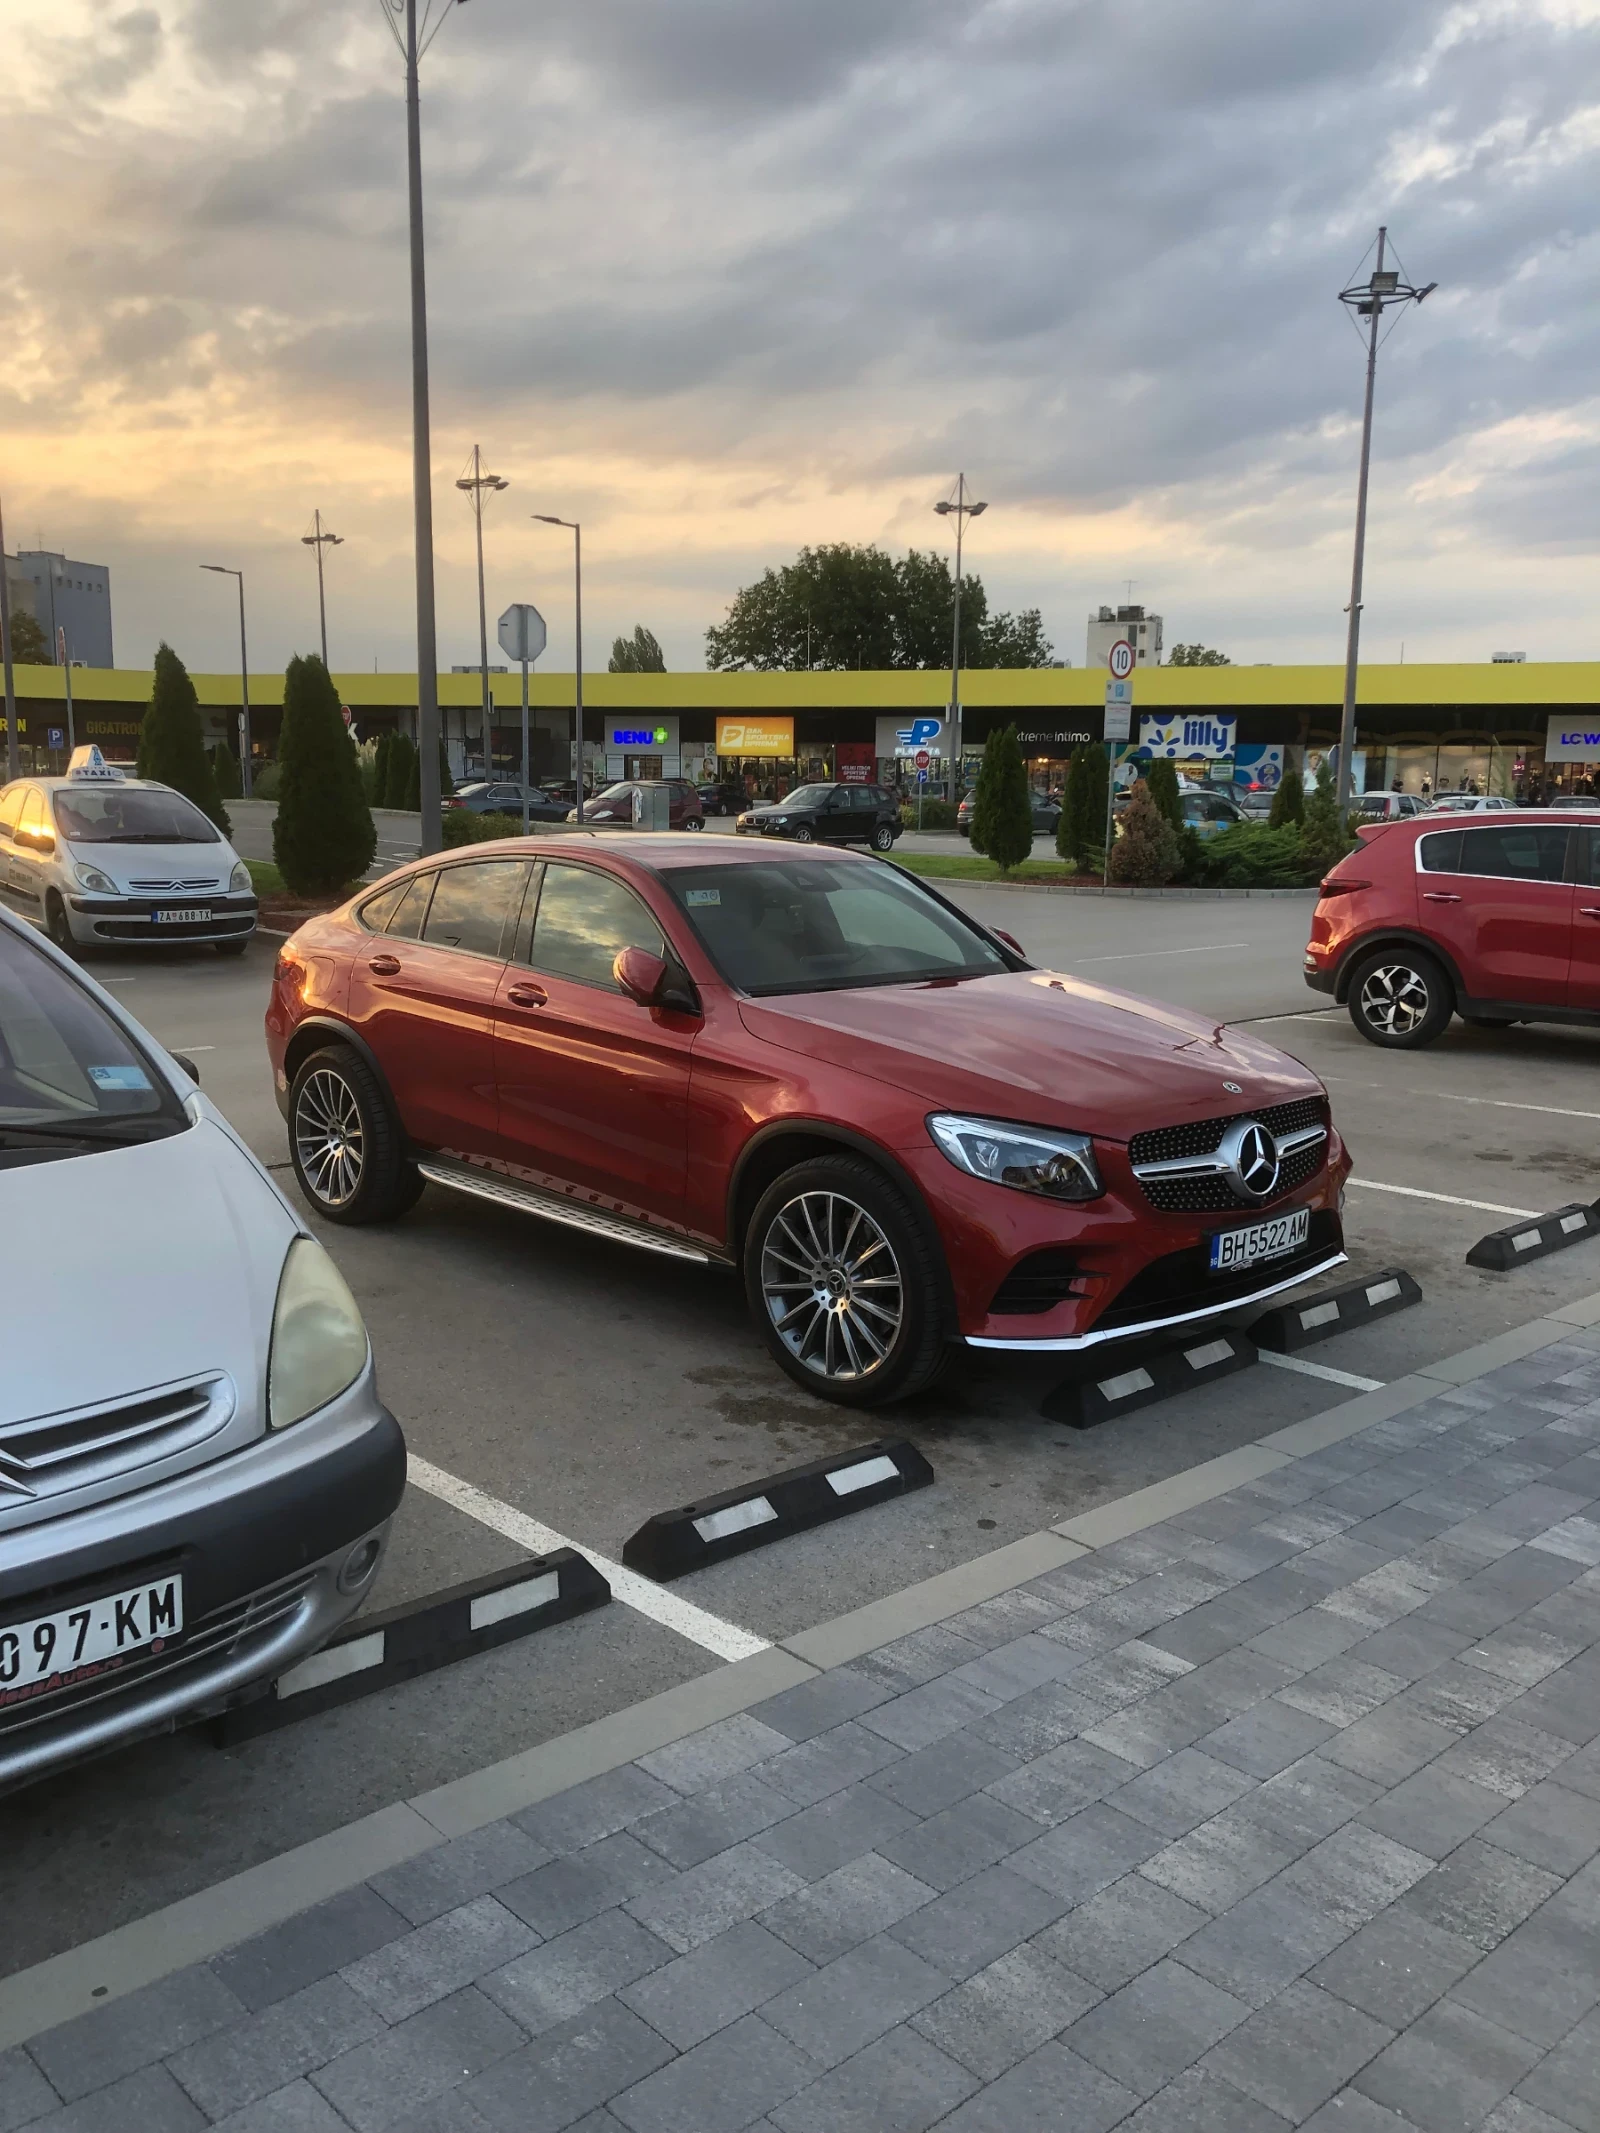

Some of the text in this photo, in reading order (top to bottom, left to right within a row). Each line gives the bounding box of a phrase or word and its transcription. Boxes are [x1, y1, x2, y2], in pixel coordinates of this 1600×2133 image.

[1116, 650, 1128, 670] 10
[0, 718, 26, 732] RN
[52, 730, 60, 741] P
[613, 730, 653, 744] BENU
[1054, 731, 1091, 742] intimo
[1184, 721, 1227, 753] lilly
[894, 747, 940, 756] PLANTA
[916, 756, 928, 764] STOP
